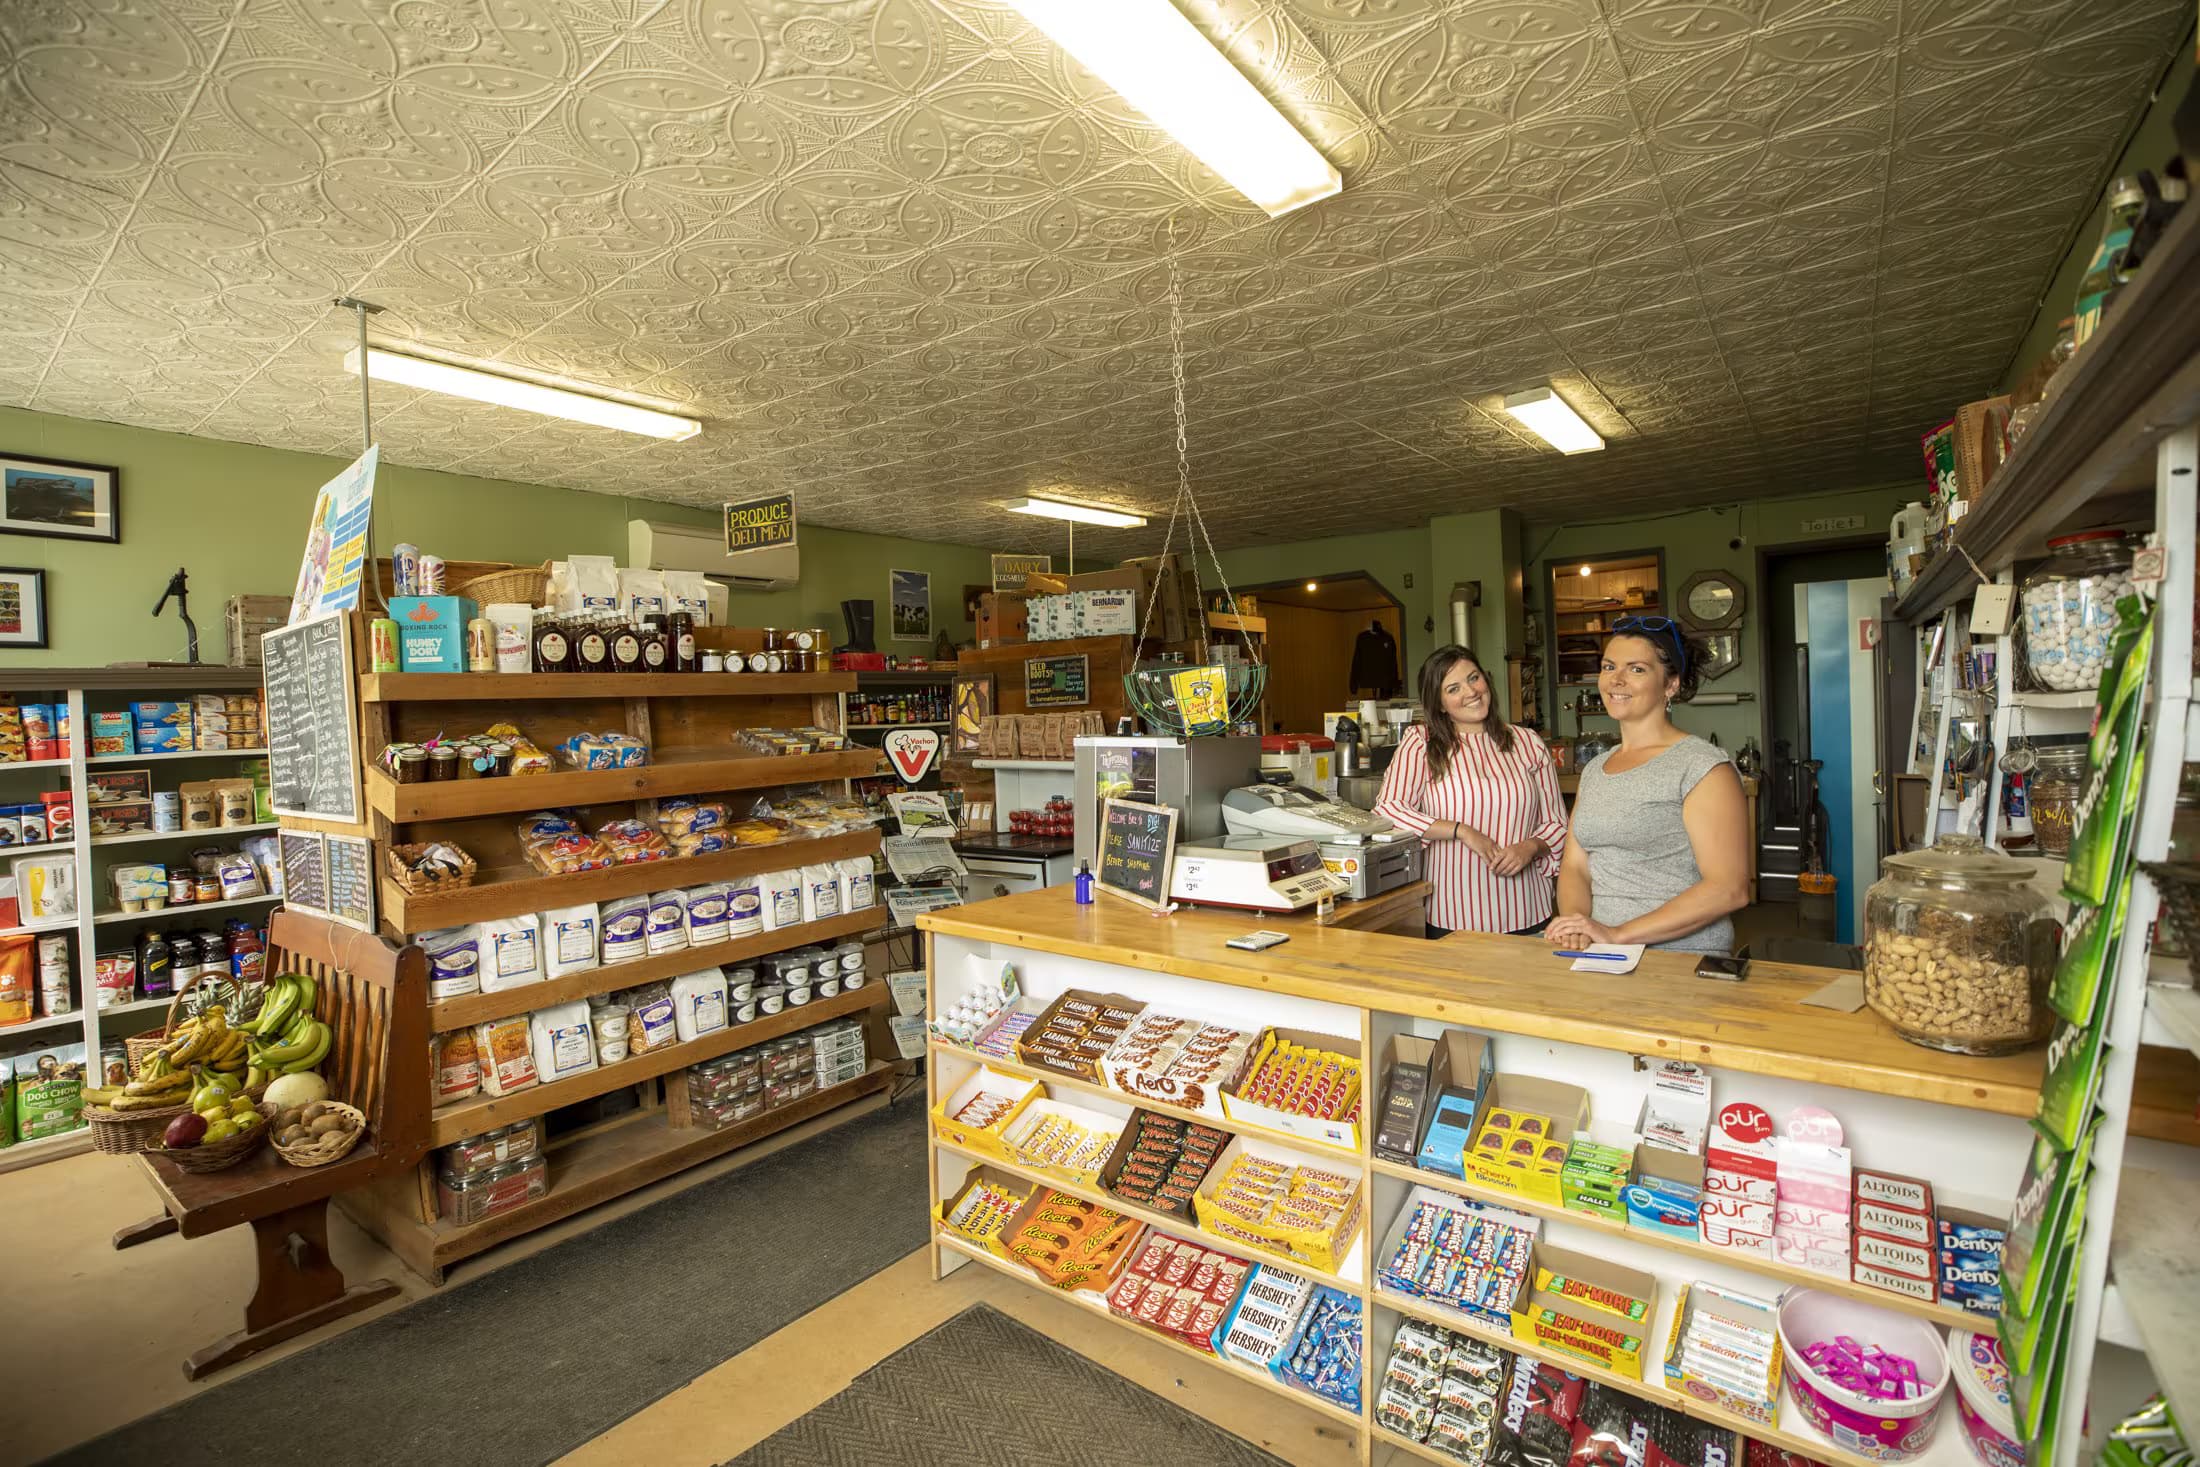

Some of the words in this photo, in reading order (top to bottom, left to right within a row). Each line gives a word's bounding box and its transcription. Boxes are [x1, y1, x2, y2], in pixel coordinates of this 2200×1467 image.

[730, 503, 788, 527] PRODUCE
[731, 528, 757, 546] DELI
[761, 522, 791, 543] MEAT
[1004, 562, 1041, 573] DAIRY
[1092, 597, 1125, 607] BERNARDIN
[406, 638, 442, 648] HUNKY
[410, 647, 439, 656] DORY
[1127, 833, 1162, 851] SANITIZE
[1064, 1000, 1098, 1014] CARAMILK
[1052, 1015, 1087, 1029] CARAMILK
[1041, 1031, 1078, 1044] CARAMILK
[1043, 1056, 1077, 1072] CARAMILK
[1183, 1054, 1211, 1064] Aero
[1170, 1068, 1199, 1078] Aero
[1136, 1072, 1176, 1094] Aero
[26, 1091, 48, 1103] DOG
[50, 1085, 79, 1100] CHOW
[1721, 1109, 1766, 1130] pür
[1479, 1166, 1511, 1182] Cherry
[1583, 1161, 1610, 1171] HALLS
[1475, 1173, 1517, 1190] Blossom
[1863, 1180, 1920, 1199] ALTOIDS
[1047, 1191, 1083, 1208] Reese
[1579, 1194, 1609, 1207] HALLS
[1036, 1208, 1072, 1224] Reese
[1700, 1200, 1753, 1218] pür
[1864, 1210, 1923, 1231] ALTOIDS
[1023, 1226, 1058, 1241] Reese
[1084, 1223, 1117, 1253] Reese
[1013, 1243, 1049, 1259] Reese
[1864, 1243, 1924, 1265] ALTOIDS
[1057, 1261, 1096, 1273] Reese
[1863, 1271, 1926, 1294] ALTOIDS
[1249, 1282, 1297, 1310] HERSHEY'S
[1239, 1306, 1287, 1333] HERSHEY'S
[1228, 1328, 1278, 1359] HERSHEY'S
[1393, 1362, 1419, 1377] Liquorice
[1456, 1359, 1480, 1378] TOFFEE
[1665, 1369, 1683, 1379] NEW
[1387, 1394, 1412, 1410] Liquorice
[1387, 1403, 1410, 1420] TOFFEE
[1441, 1416, 1467, 1431] Liquorice
[1440, 1423, 1464, 1441] TOFFEE
